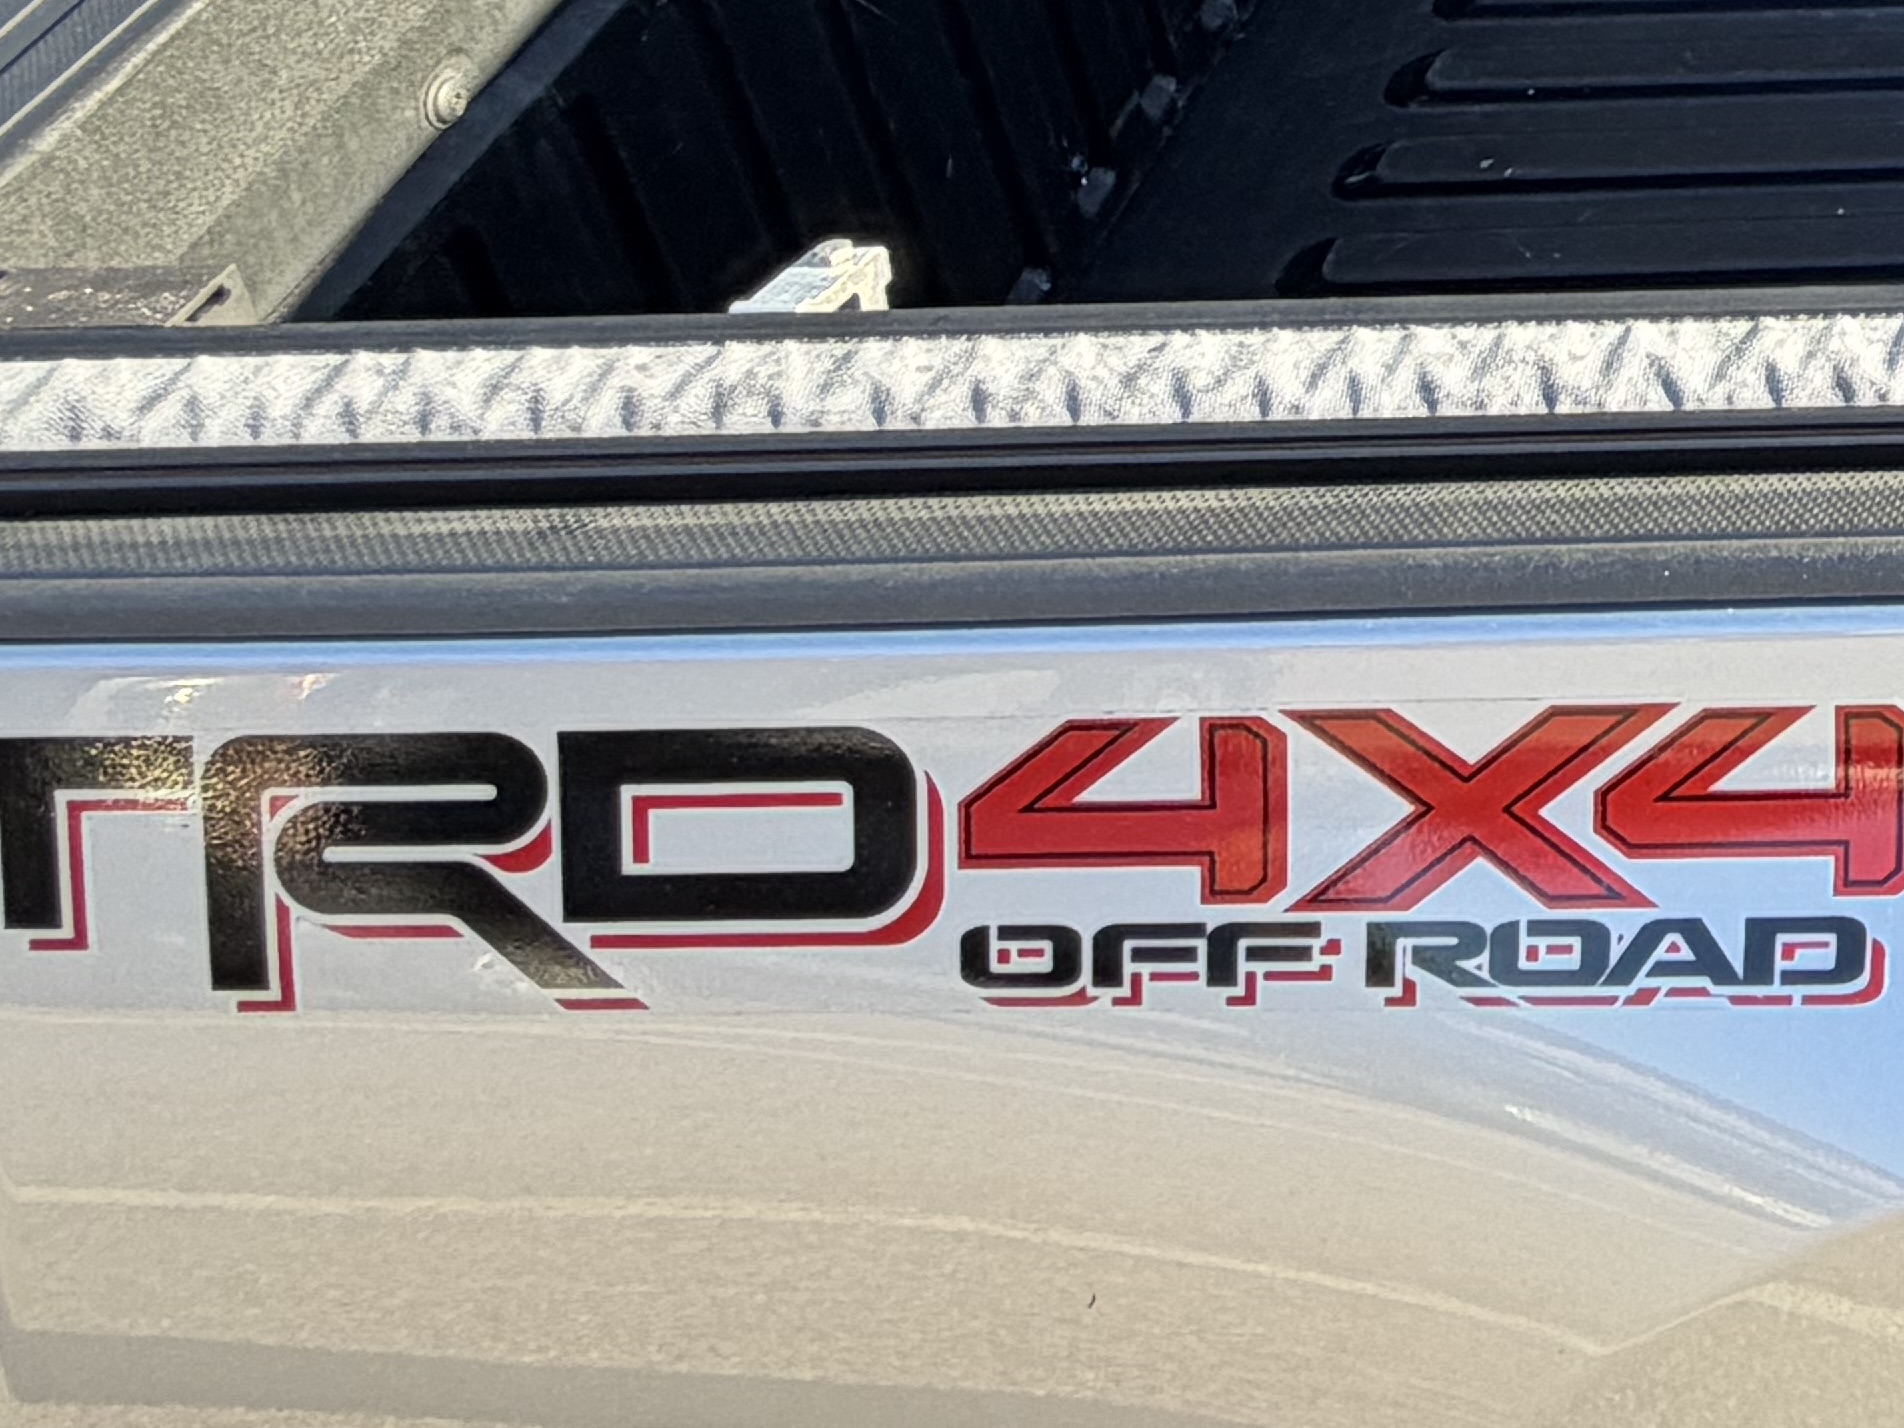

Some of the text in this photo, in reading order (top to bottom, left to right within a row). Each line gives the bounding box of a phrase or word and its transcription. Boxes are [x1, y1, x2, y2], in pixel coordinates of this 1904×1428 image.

[0, 726, 944, 1011] TRD
[959, 915, 1886, 1008] OFF ROAD
